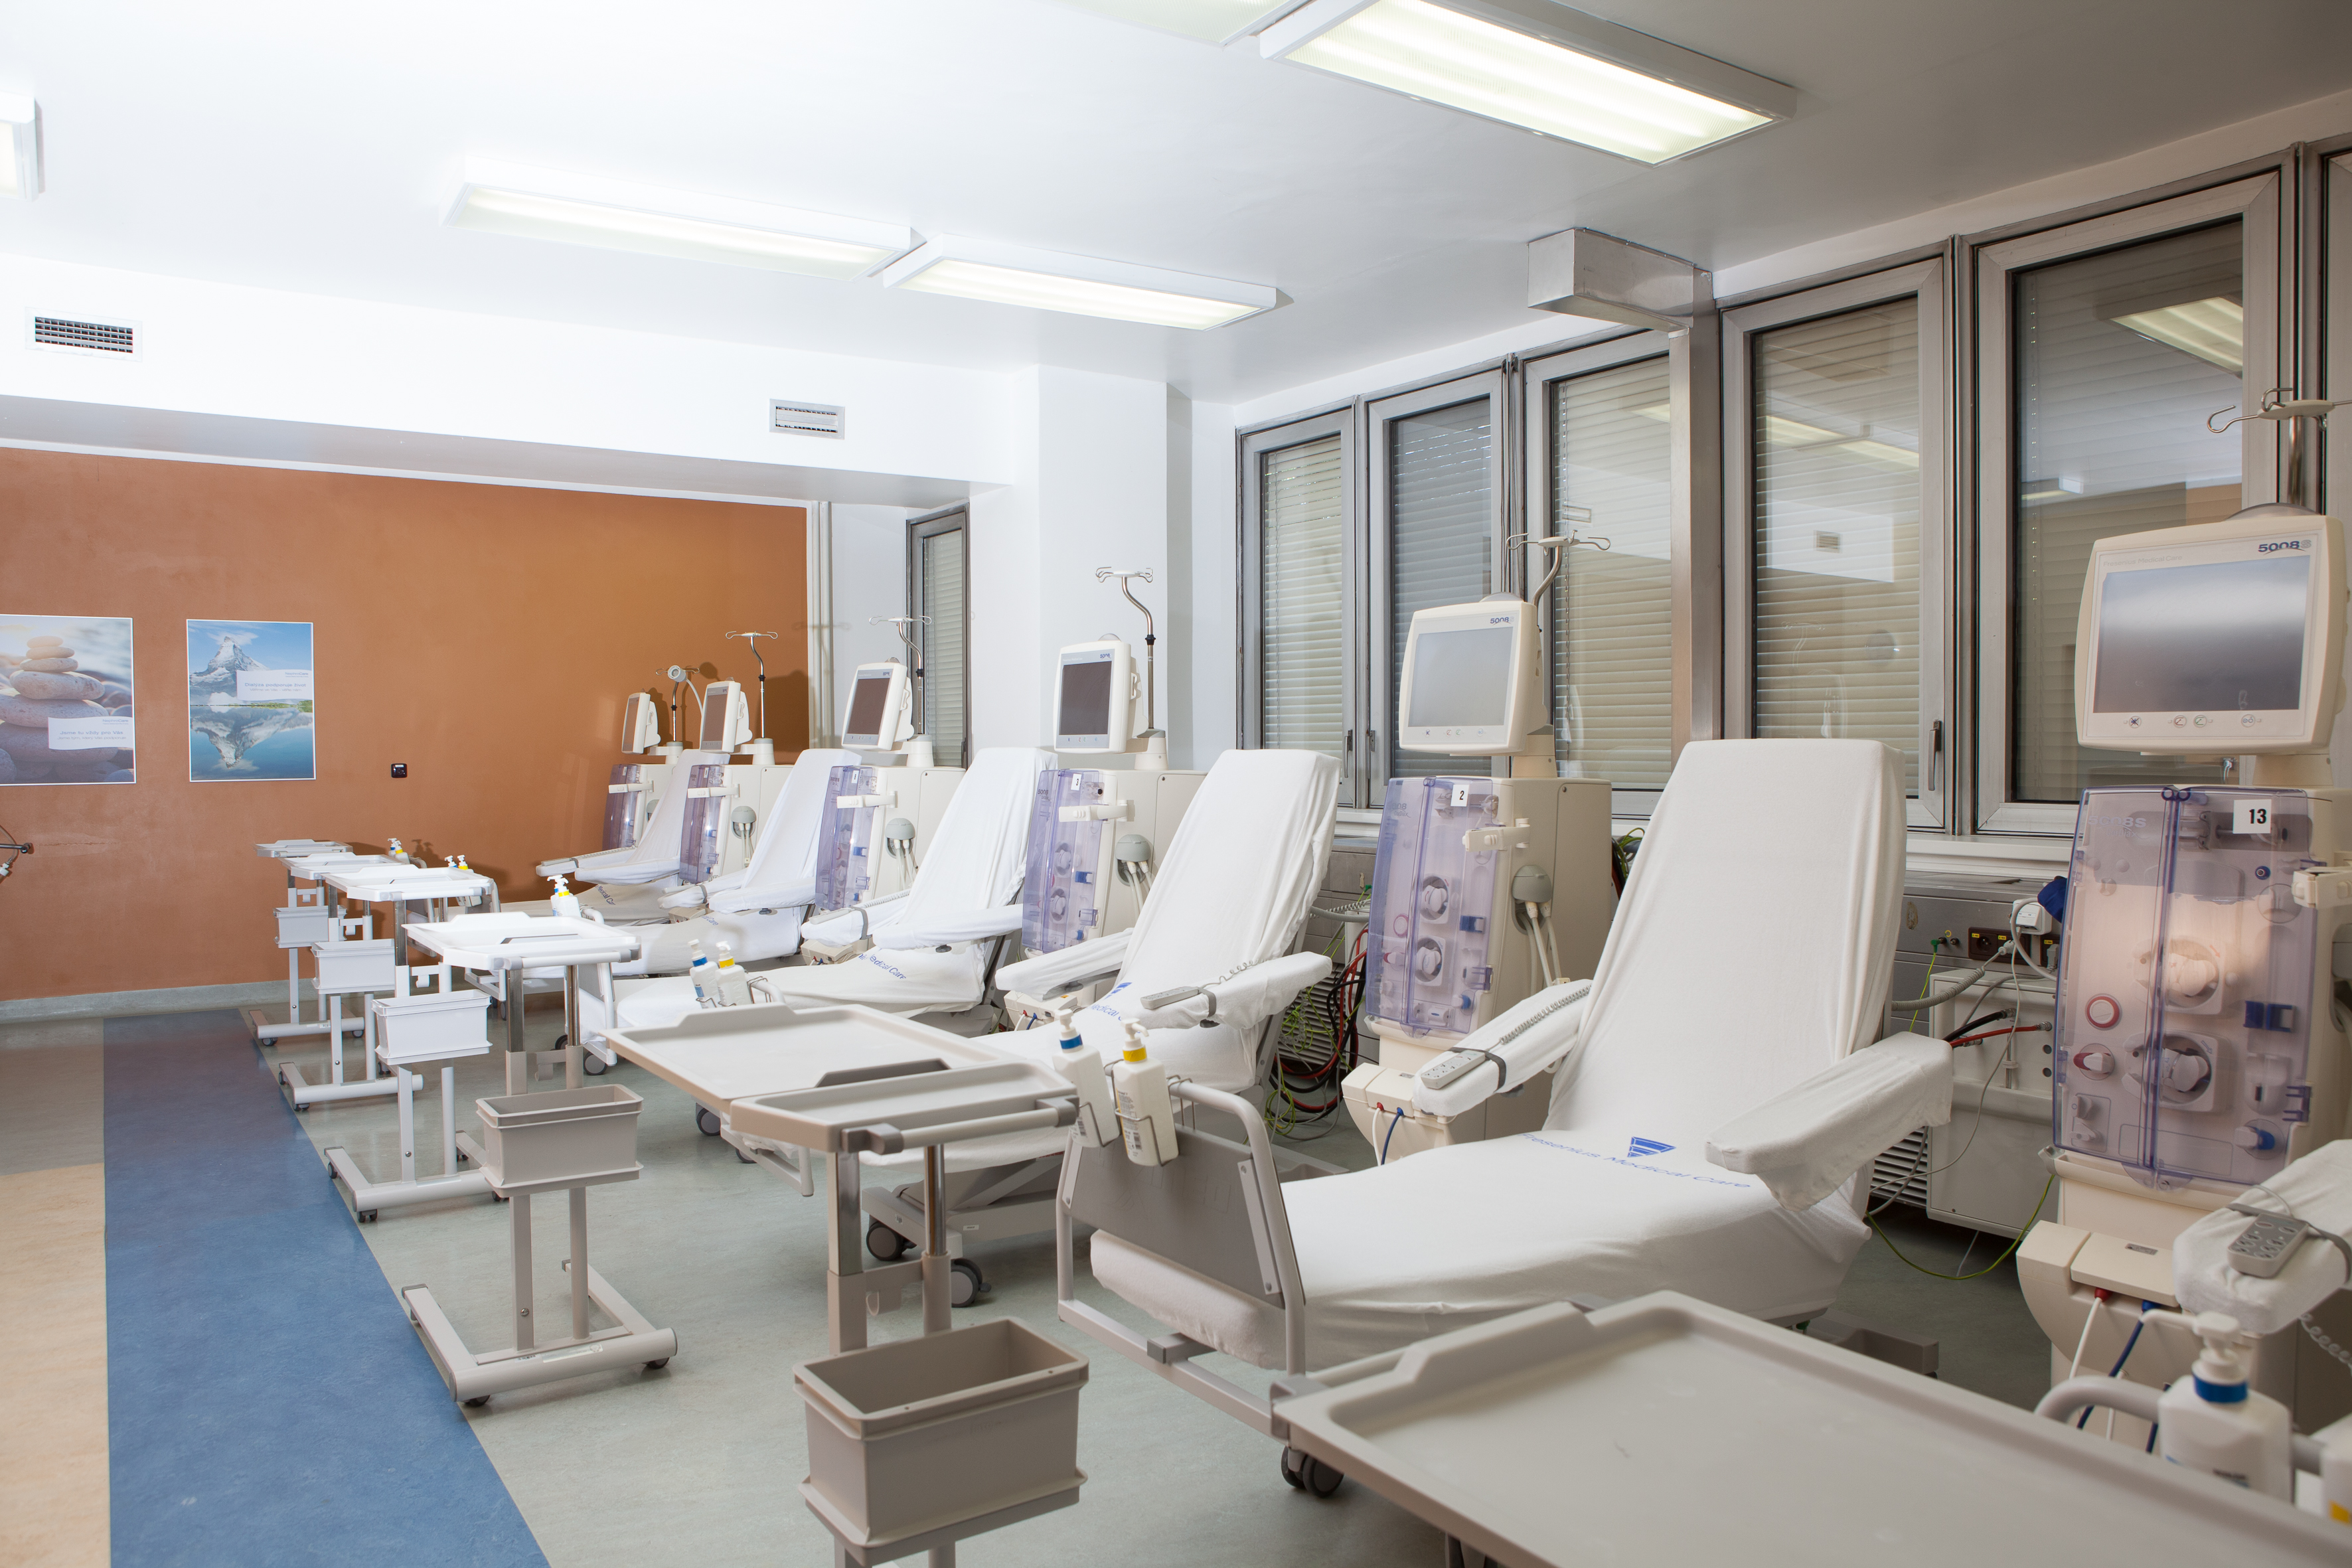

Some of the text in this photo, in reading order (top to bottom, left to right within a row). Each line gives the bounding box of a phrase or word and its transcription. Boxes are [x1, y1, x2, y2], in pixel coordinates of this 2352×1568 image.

[1459, 790, 1464, 801] 2
[2088, 815, 2147, 828] 5008S
[2248, 808, 2267, 824] 13
[1518, 1133, 1751, 1188] Fresenius Medical Care
